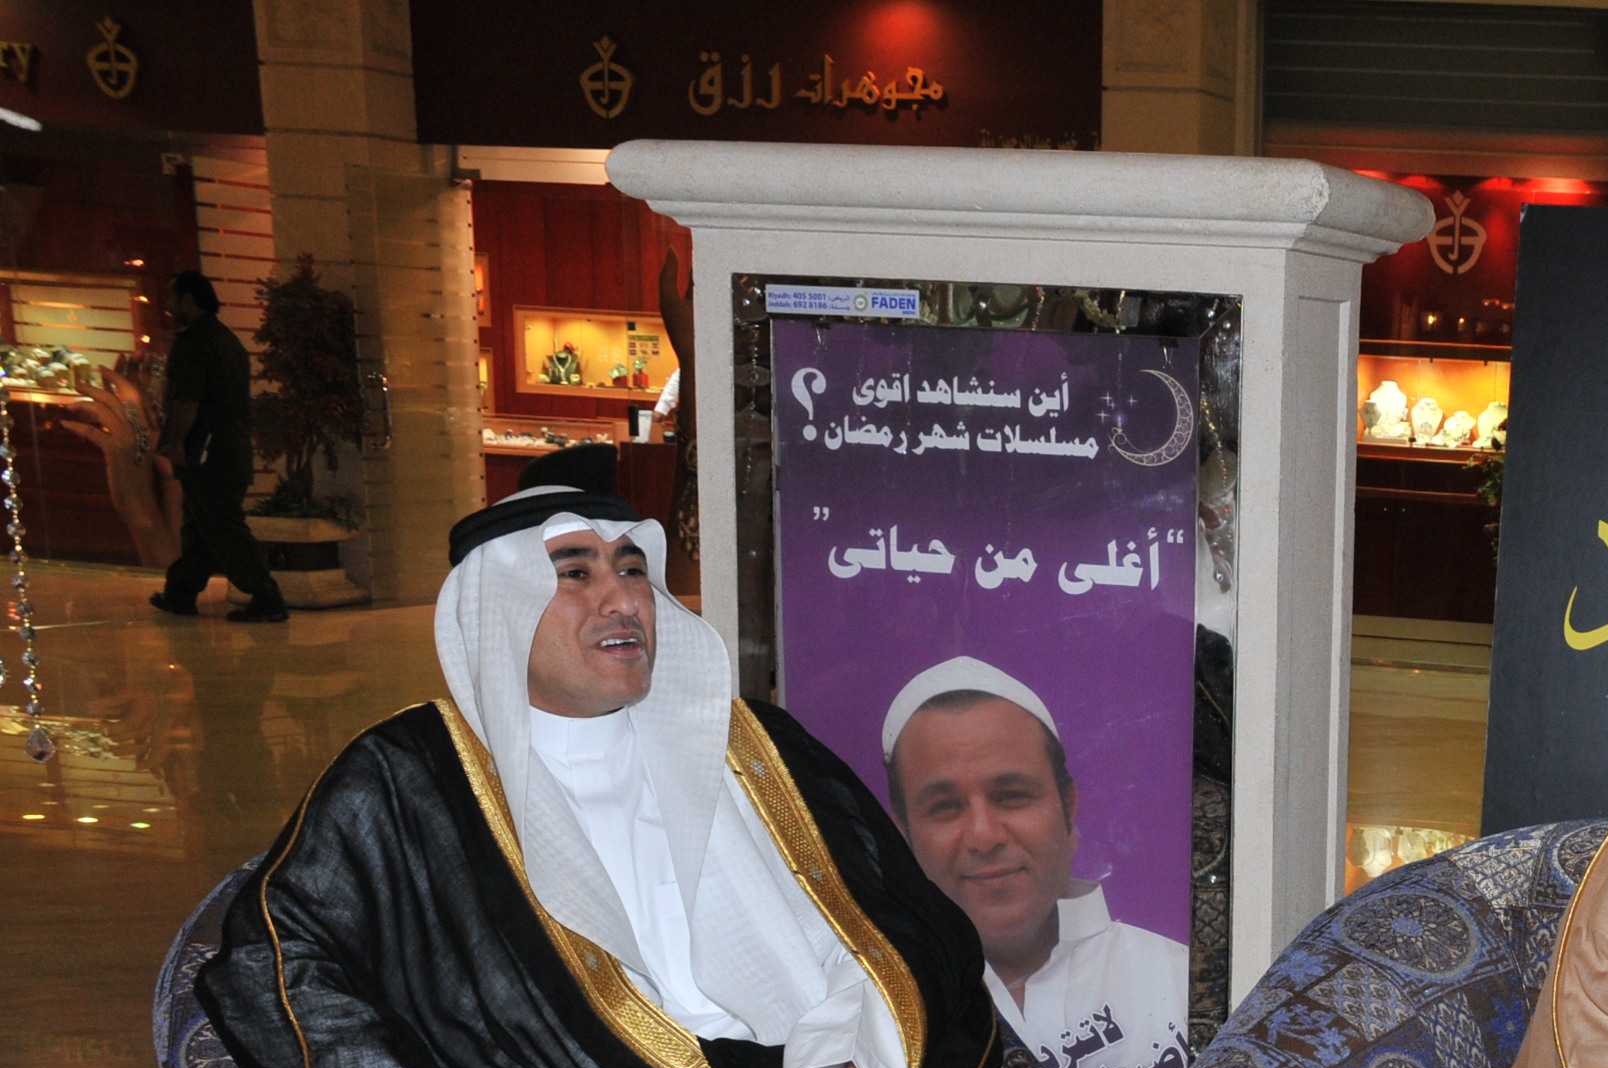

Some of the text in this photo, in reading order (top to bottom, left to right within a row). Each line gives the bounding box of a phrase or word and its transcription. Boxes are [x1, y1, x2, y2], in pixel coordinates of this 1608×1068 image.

[688, 51, 944, 116] مجوهرات رزق
[792, 292, 807, 300] 405
[808, 293, 827, 301] 5001
[792, 301, 807, 309] 692
[808, 302, 828, 310] 8186
[871, 296, 916, 310] FADEN
[851, 371, 1069, 418] أين سنشاهد اقوى
[823, 414, 908, 455] رمضان
[911, 420, 971, 455] شهر
[975, 423, 1100, 460] مسلسلات
[974, 543, 1039, 590] من
